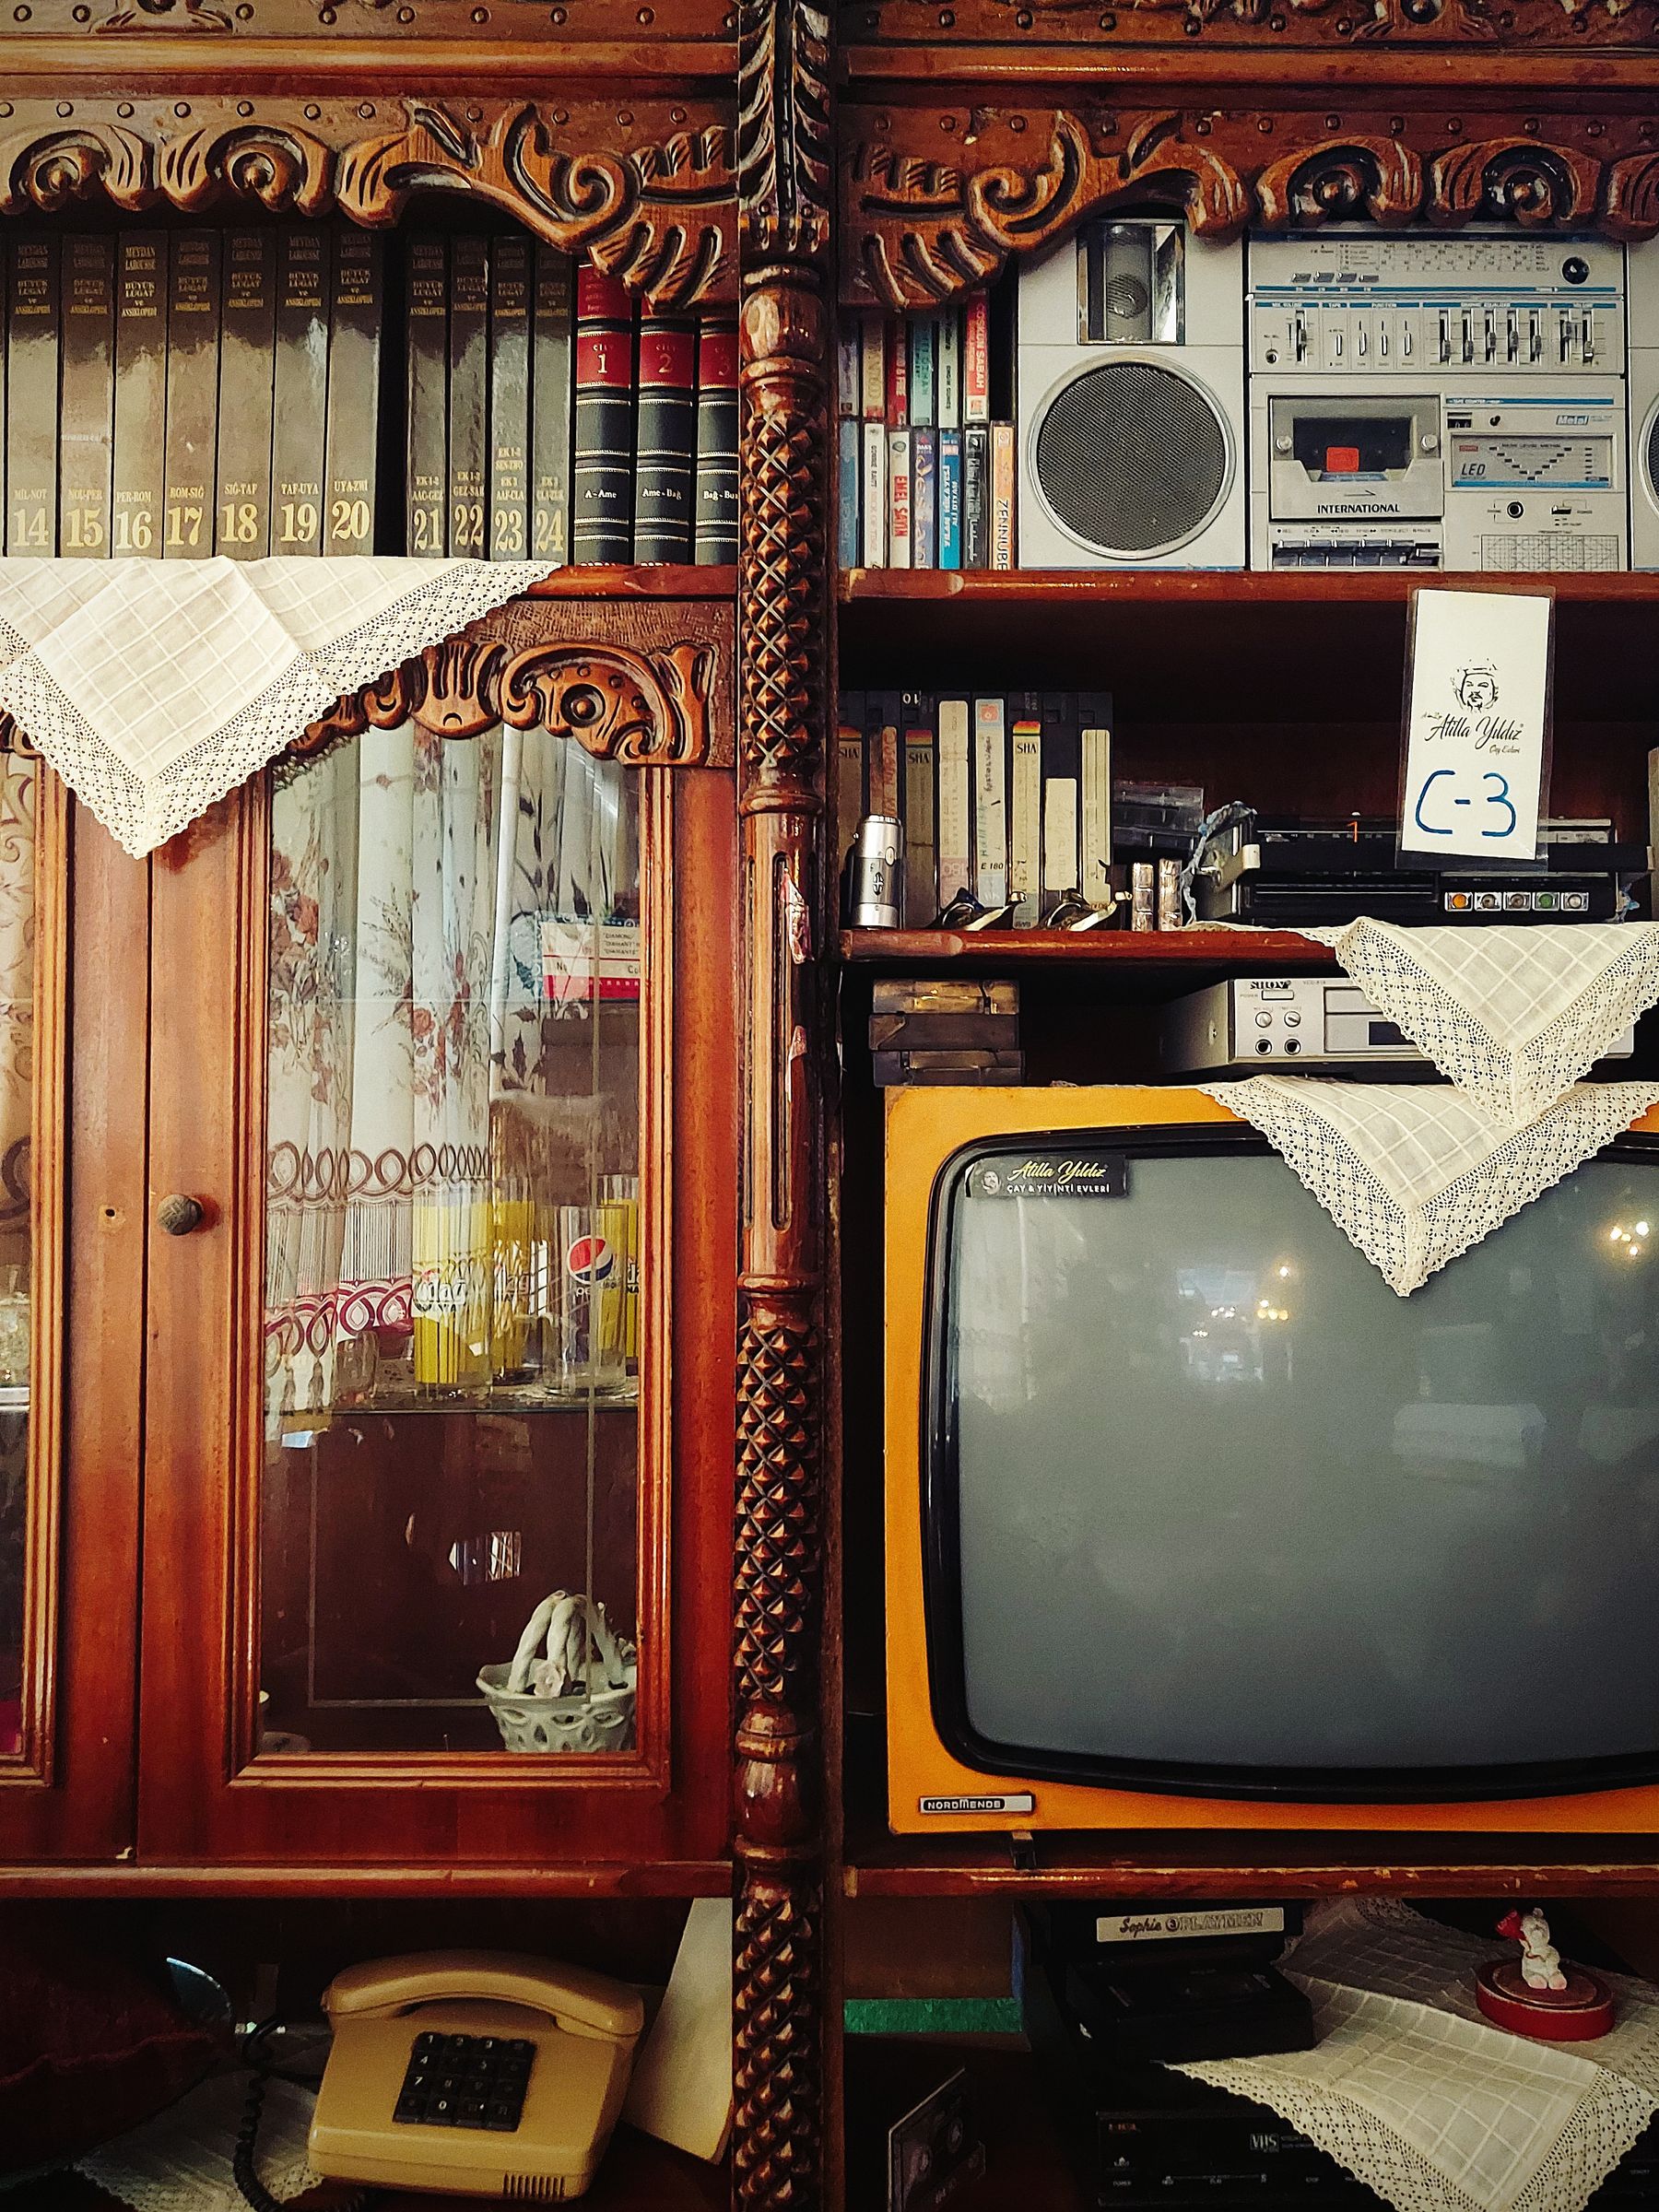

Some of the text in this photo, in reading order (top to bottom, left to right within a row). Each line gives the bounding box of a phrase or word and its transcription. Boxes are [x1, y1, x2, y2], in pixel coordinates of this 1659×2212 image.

[597, 353, 609, 374] 1
[657, 353, 673, 374] 2
[975, 349, 985, 389] SABAH
[1558, 416, 1589, 426] Metal
[1461, 463, 1486, 476] LED
[894, 475, 908, 503] EMEL
[220, 503, 259, 543] 18
[280, 502, 318, 543] 19
[332, 500, 371, 541] 20
[1318, 503, 1401, 515] INTERNATIONAL
[12, 508, 50, 547] 14
[65, 508, 104, 548] 15
[116, 511, 153, 550] 16
[166, 507, 204, 546] 17
[413, 509, 442, 551] 21
[454, 504, 485, 547] 22
[495, 510, 524, 552] 23
[535, 511, 565, 553] 24
[1424, 713, 1471, 742] Atilla
[908, 753, 930, 764] VHS
[1017, 743, 1037, 754] VHS
[1415, 769, 1517, 837] C-3
[1006, 1160, 1055, 1182] Atilla
[927, 1798, 1002, 1810] NORDMENDE
[428, 2034, 434, 2043] 1
[414, 2076, 423, 2087] 7
[438, 2100, 448, 2111] 0
